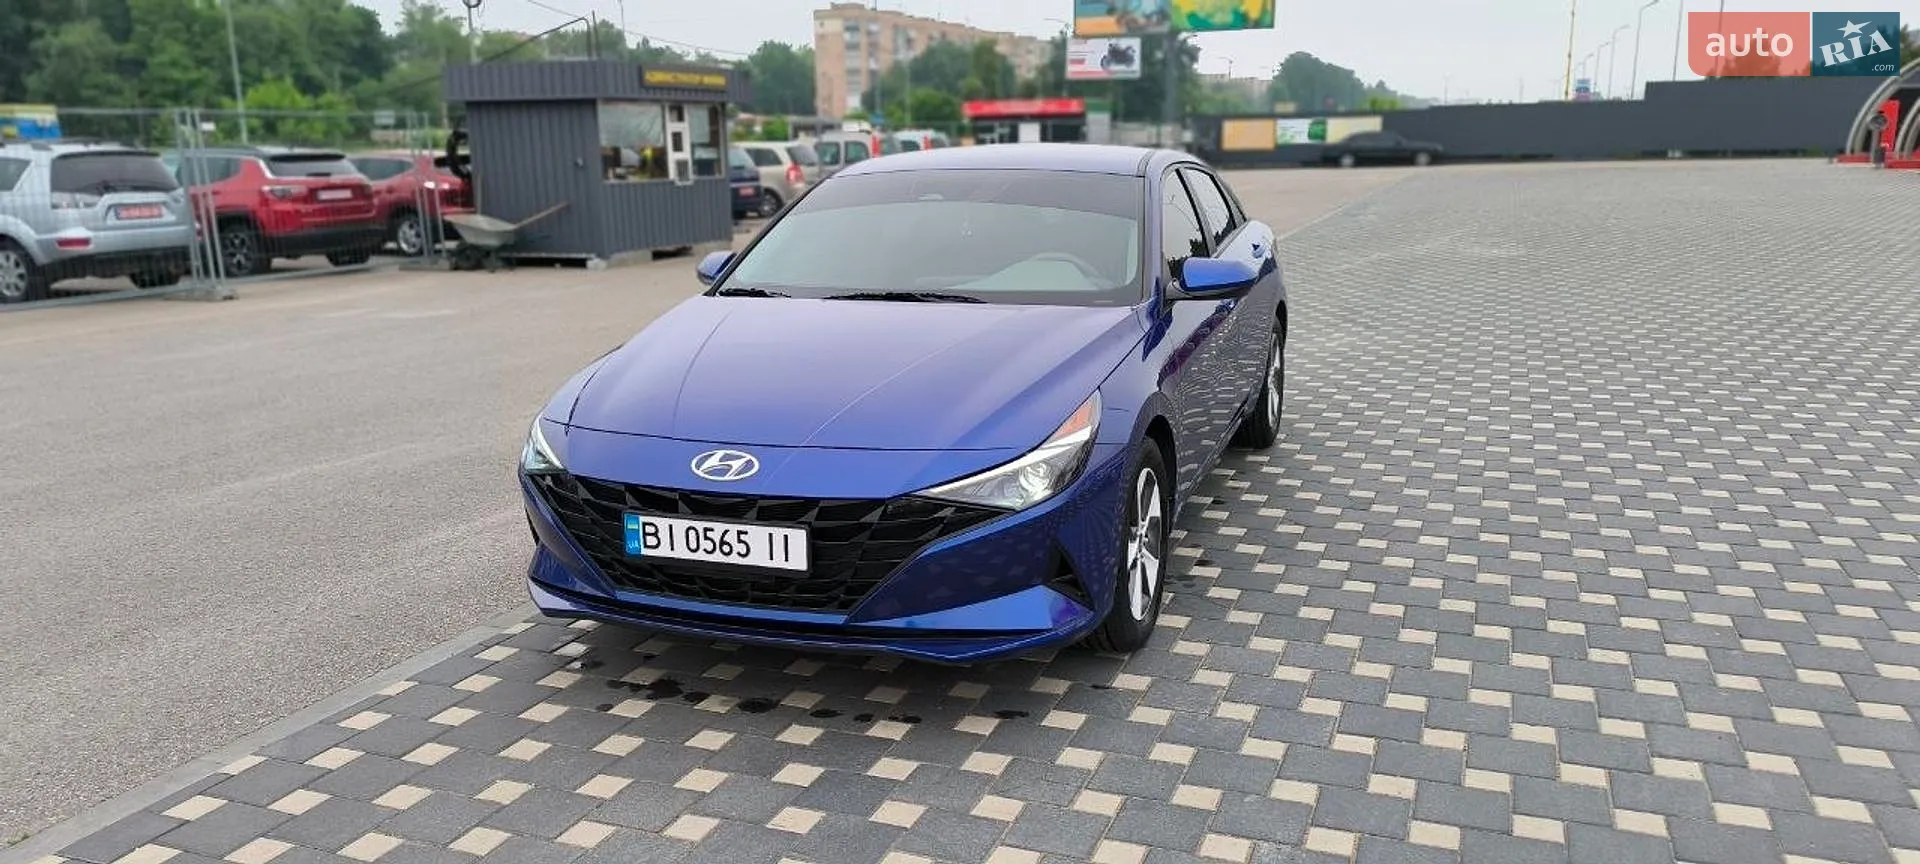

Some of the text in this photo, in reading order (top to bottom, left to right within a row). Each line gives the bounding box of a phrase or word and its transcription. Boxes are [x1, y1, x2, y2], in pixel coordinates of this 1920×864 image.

[642, 522, 789, 562] BI 0565 II
